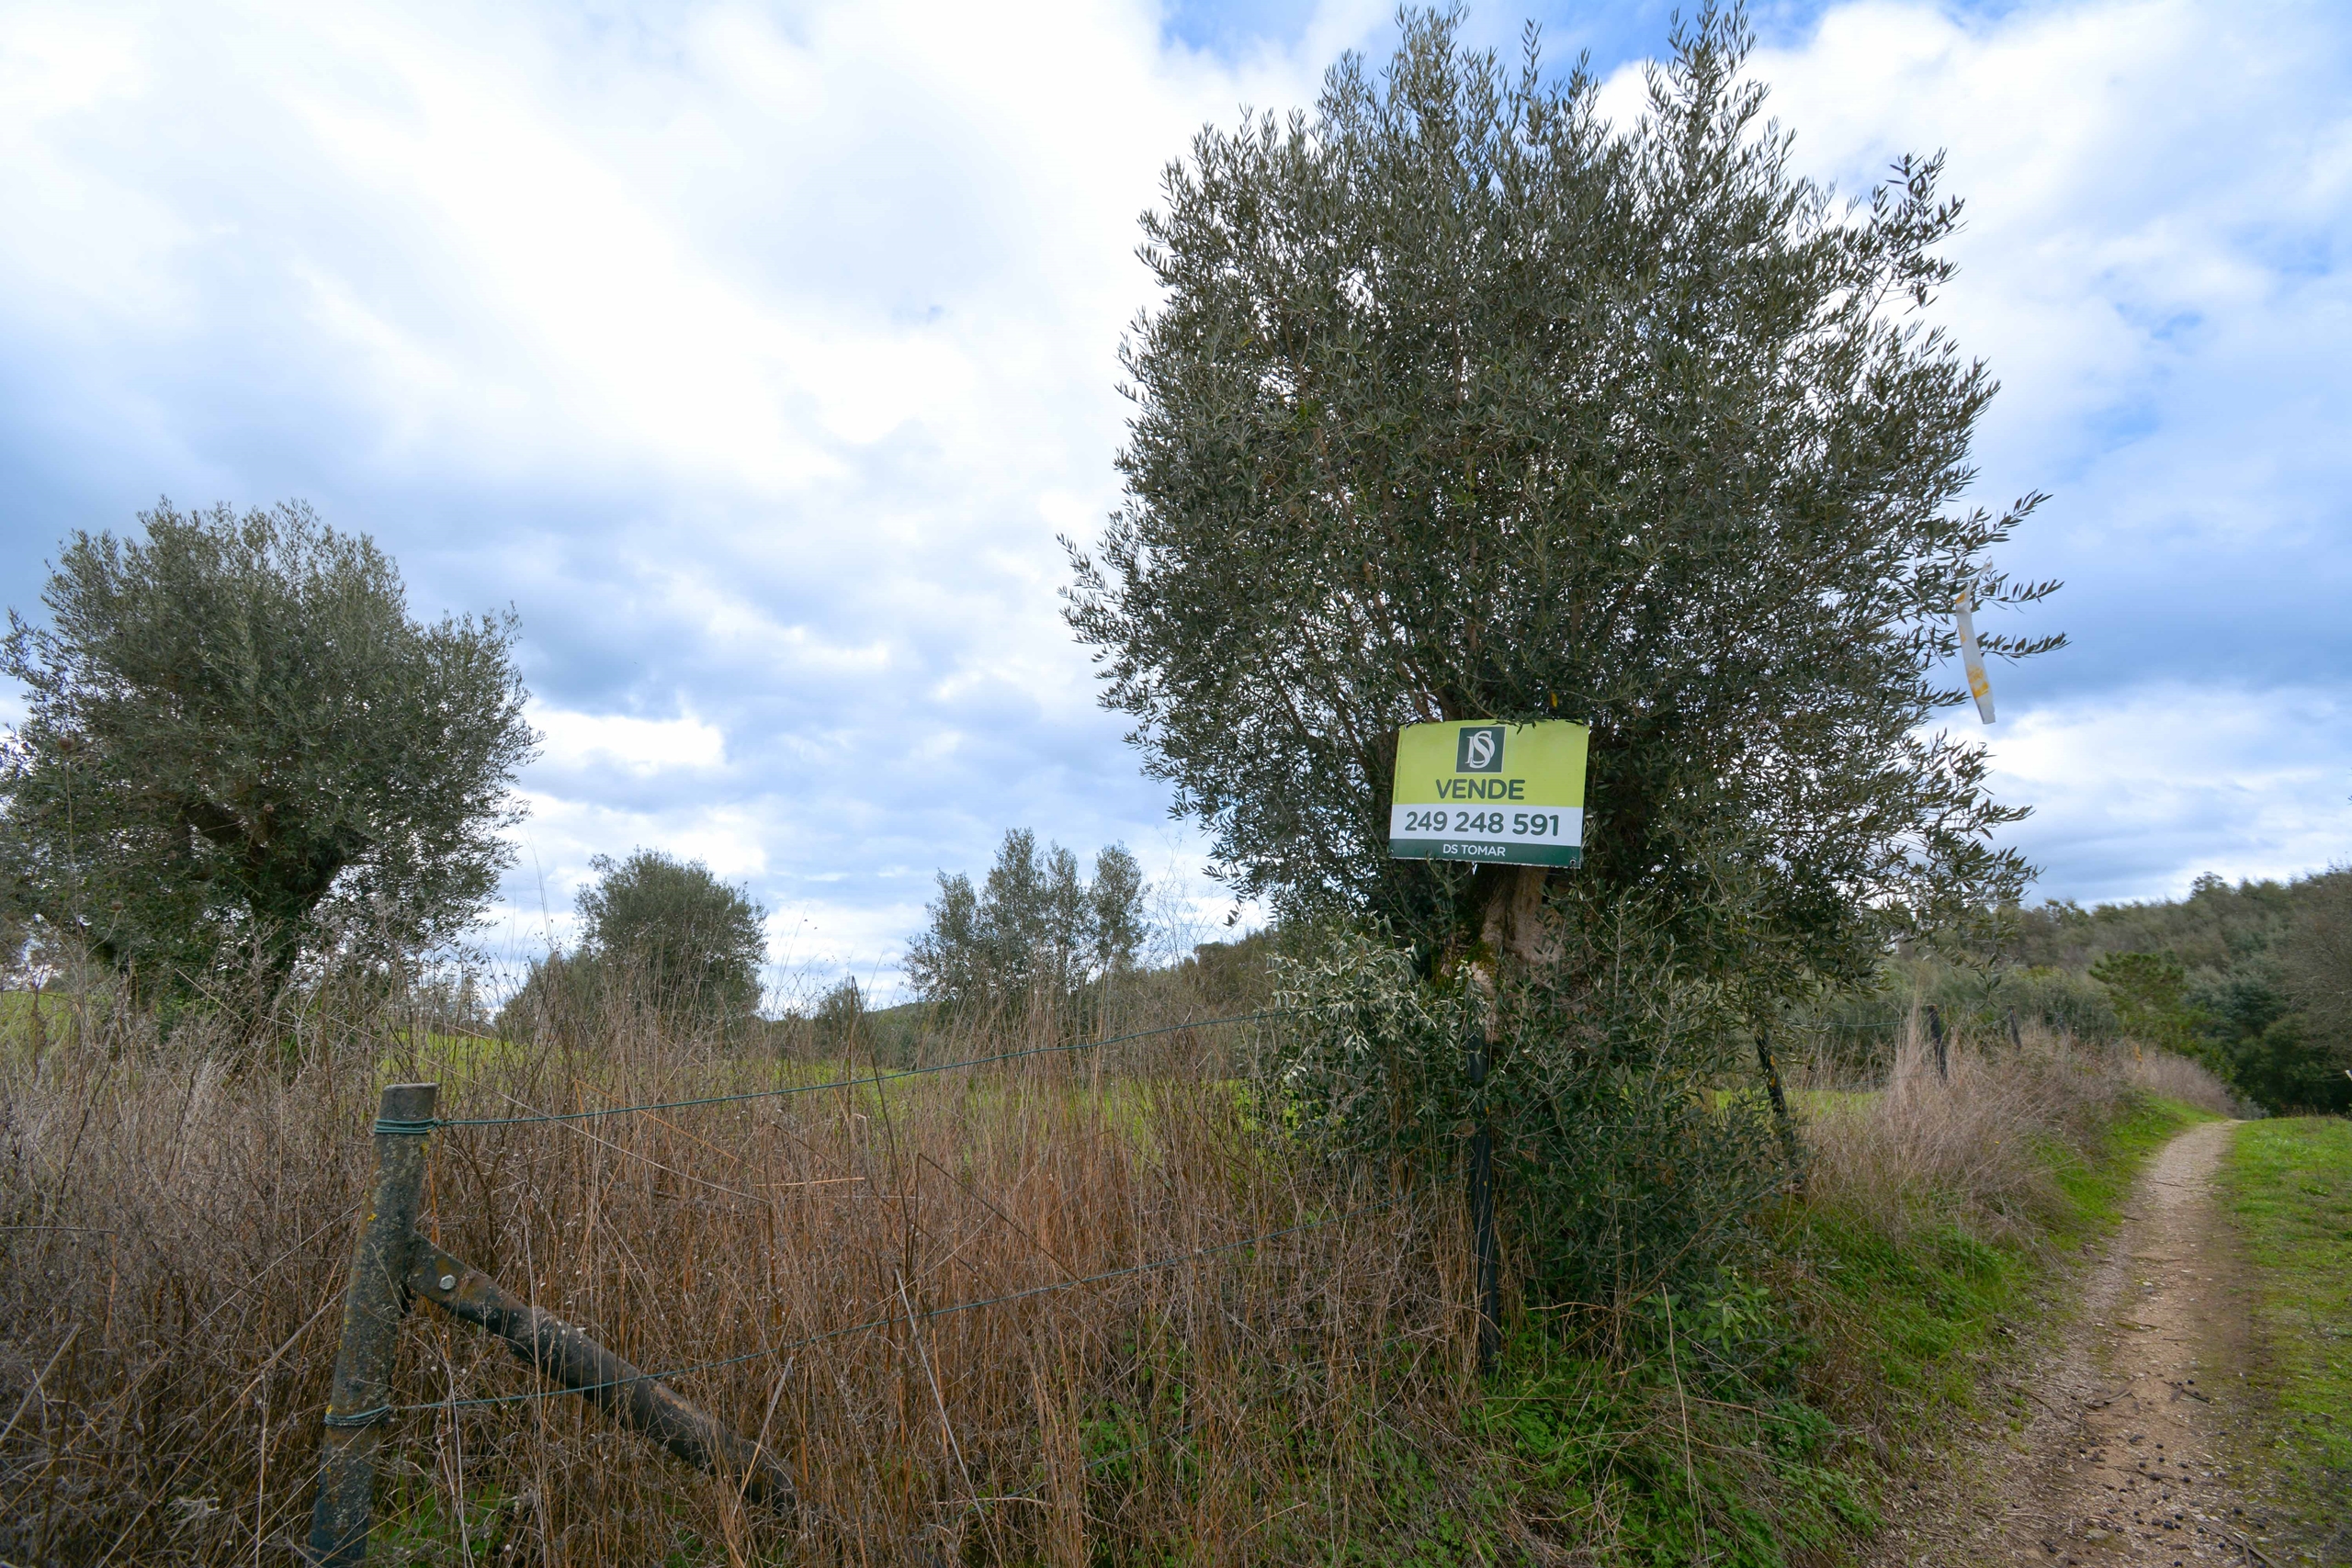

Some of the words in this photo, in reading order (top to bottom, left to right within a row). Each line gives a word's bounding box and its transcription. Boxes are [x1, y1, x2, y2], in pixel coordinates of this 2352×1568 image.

[1436, 779, 1525, 800] VENDE
[1405, 811, 1448, 831] 249
[1454, 811, 1504, 834] 248
[1512, 813, 1559, 837] 591
[1442, 843, 1458, 854] DS
[1461, 844, 1506, 857] TOMAR
